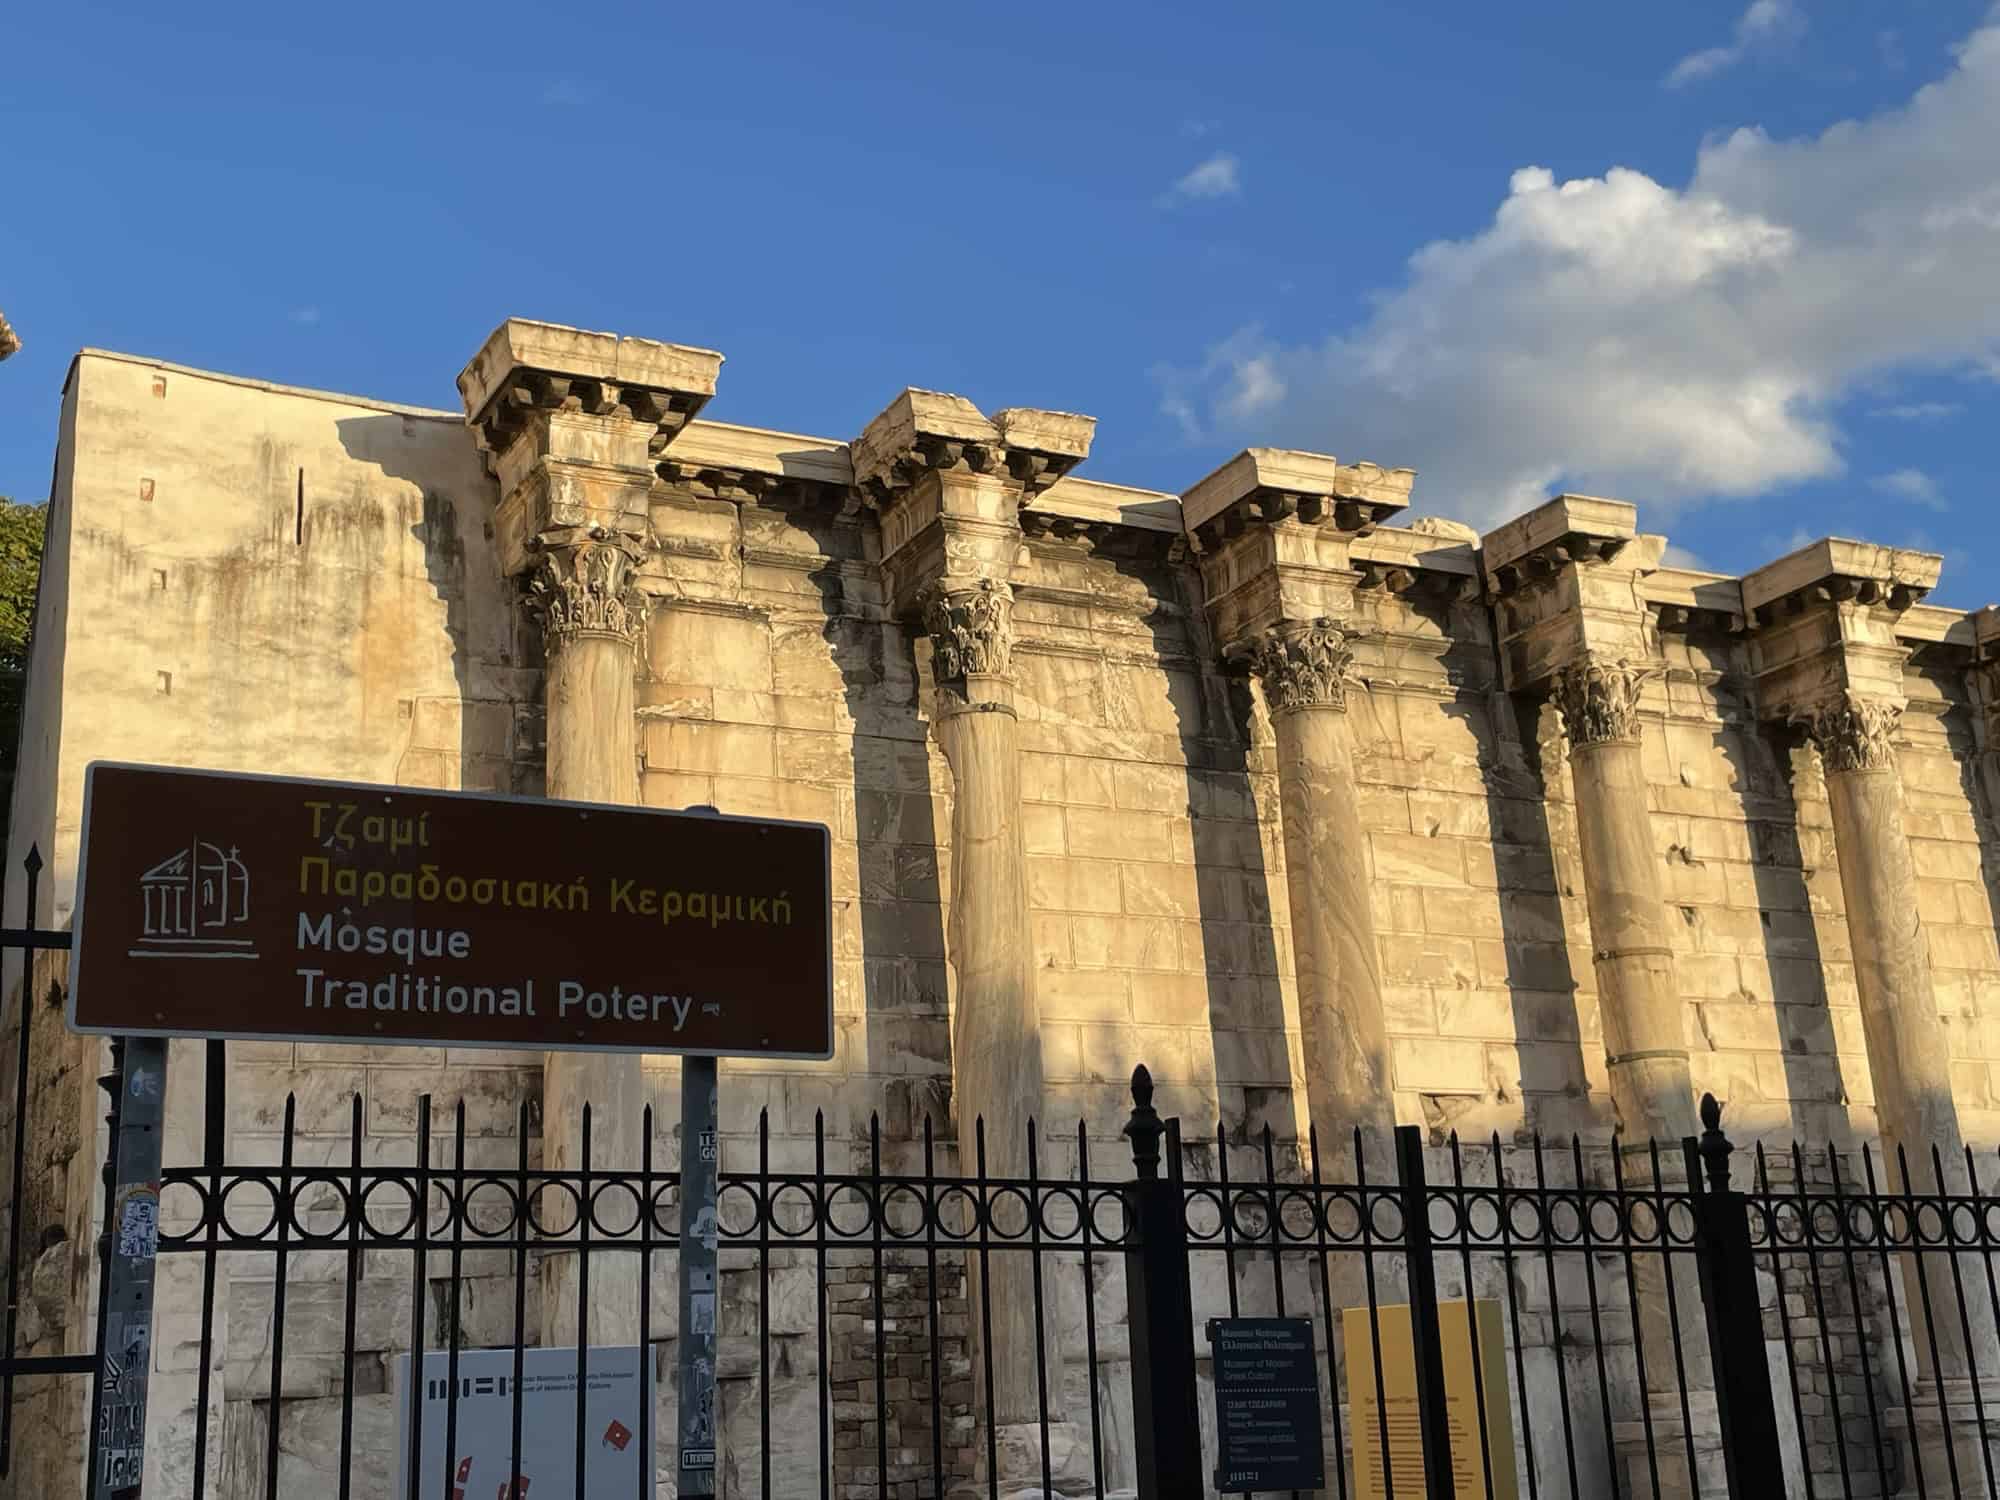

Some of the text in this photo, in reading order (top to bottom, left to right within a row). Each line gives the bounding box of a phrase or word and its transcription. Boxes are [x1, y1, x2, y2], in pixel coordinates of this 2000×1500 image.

[304, 801, 430, 855] Τζαμί
[300, 855, 792, 928] Παραδοσιακή Κεραμική
[297, 911, 471, 965] Mosque
[296, 968, 692, 1031] Traditional Potery
